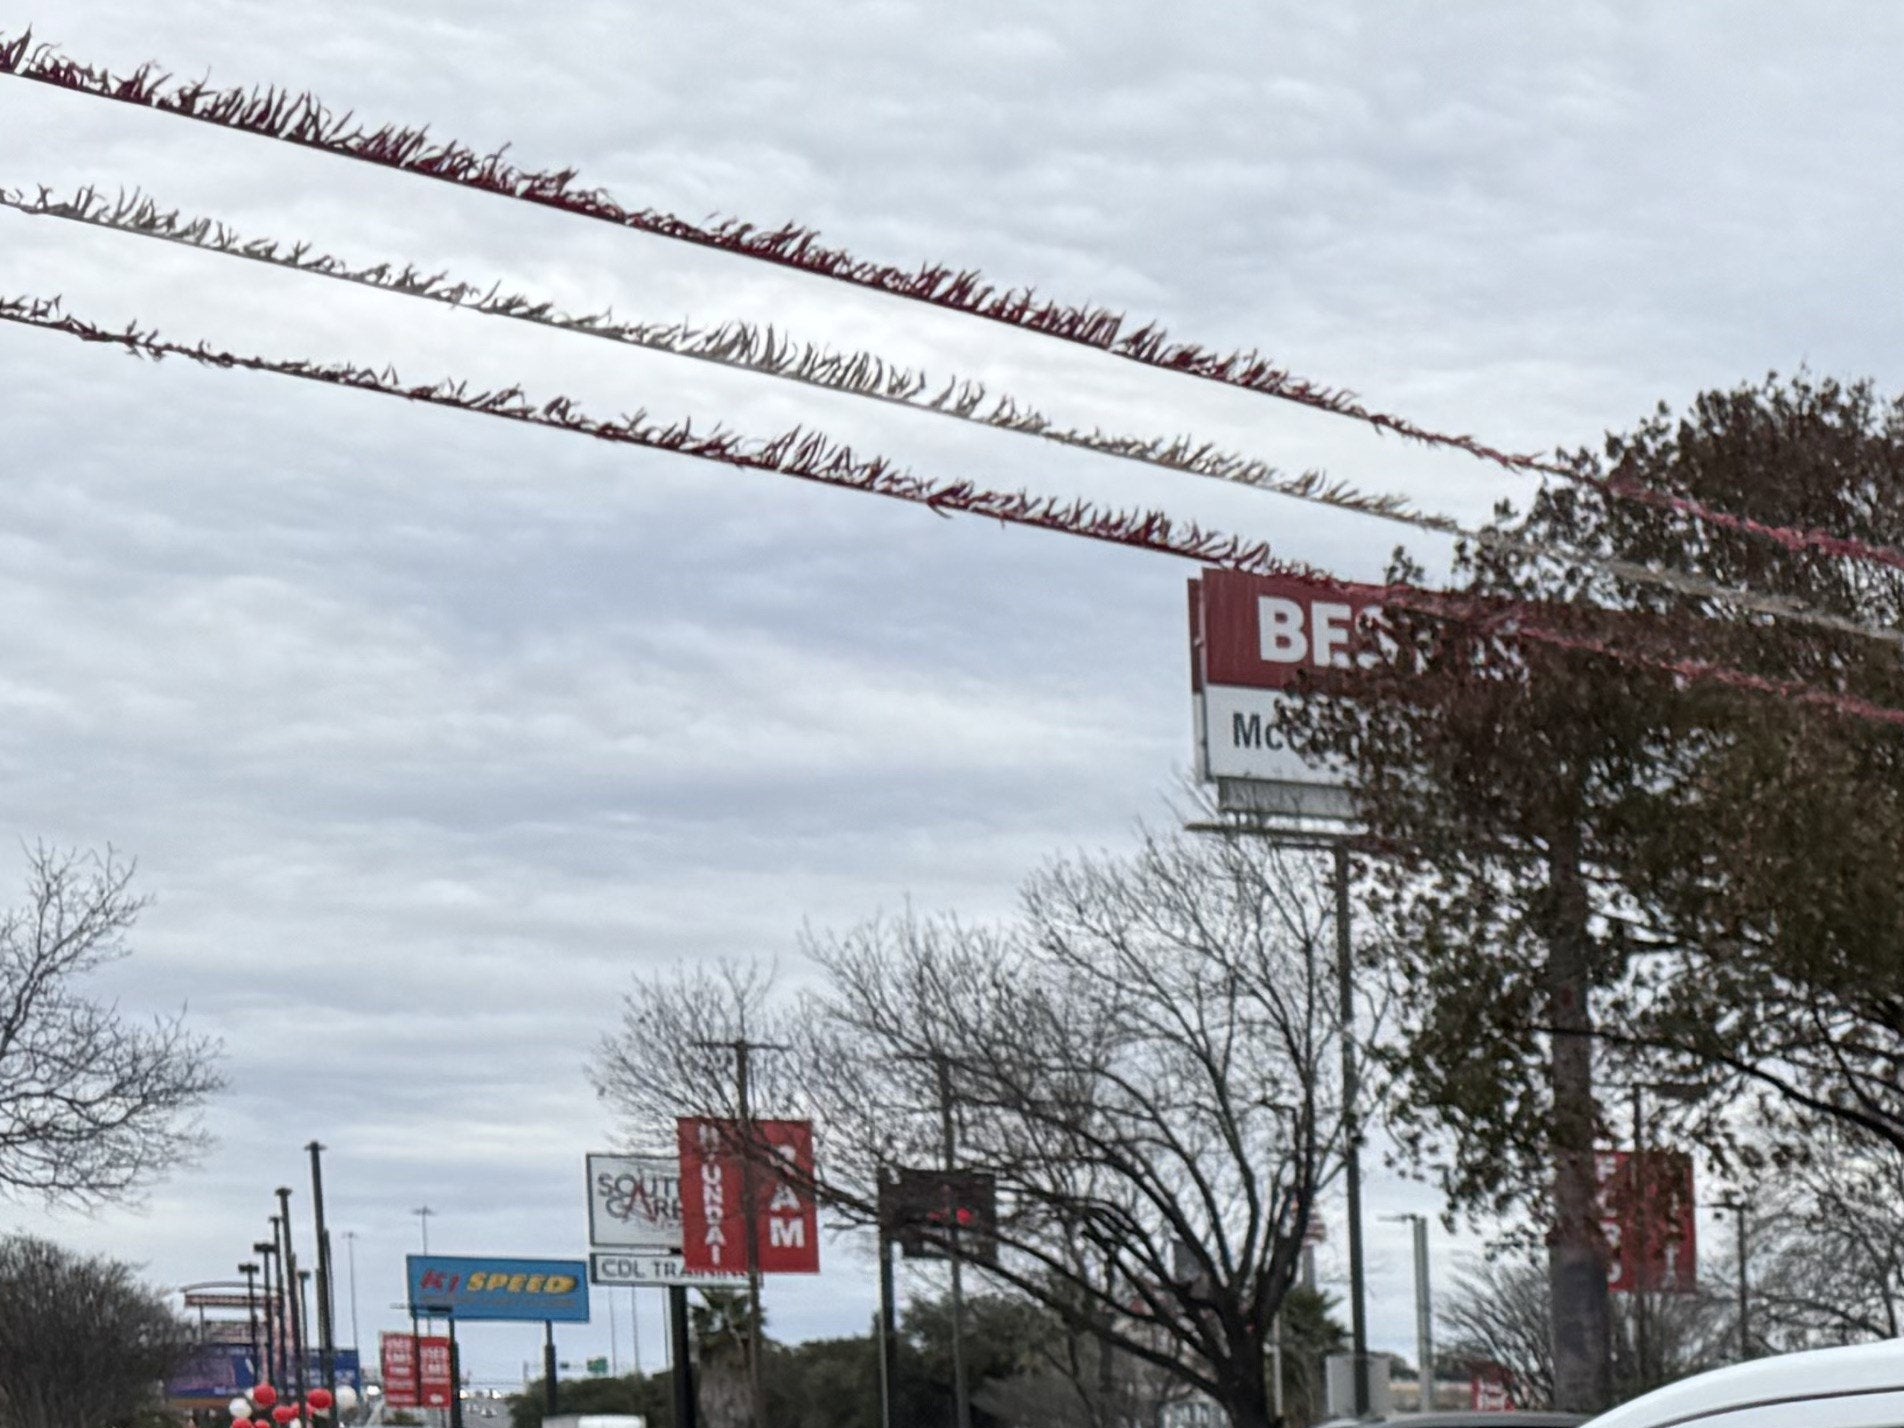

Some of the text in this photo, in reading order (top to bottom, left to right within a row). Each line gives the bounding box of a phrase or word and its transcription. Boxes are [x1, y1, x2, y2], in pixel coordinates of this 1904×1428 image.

[1257, 595, 1430, 670] BES
[601, 1258, 645, 1278] CDL
[466, 1271, 578, 1295] SPEED
